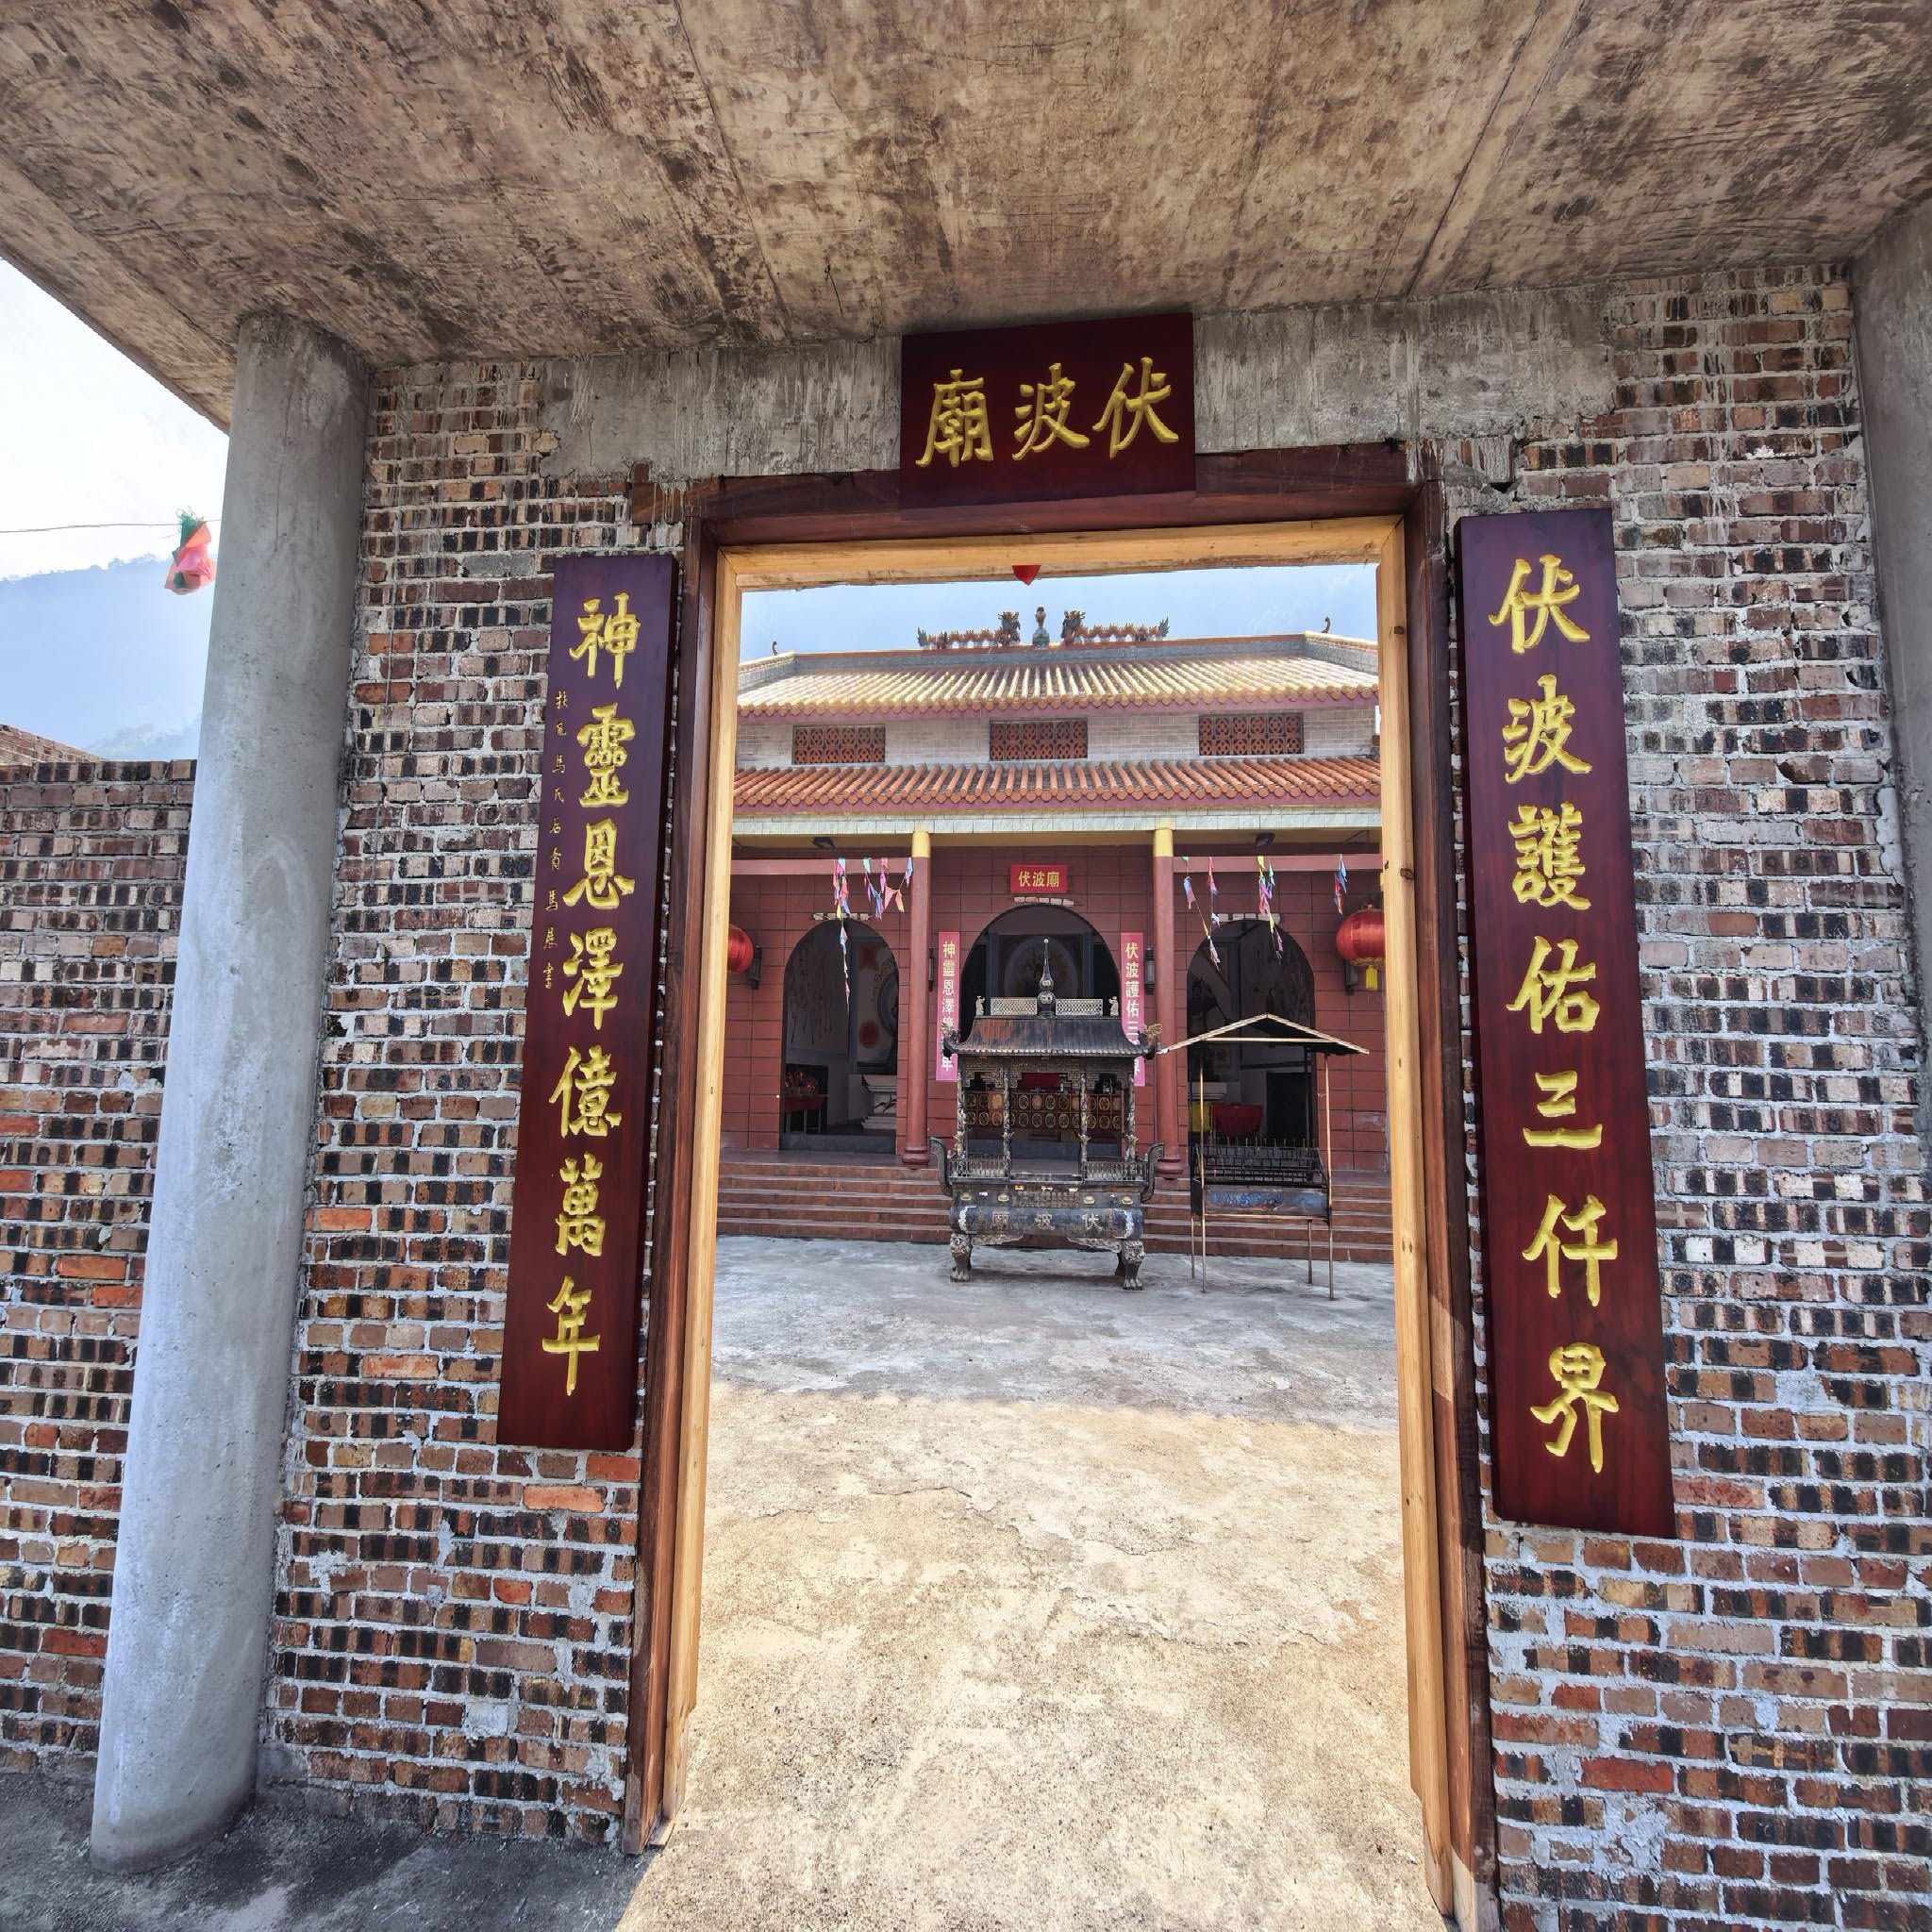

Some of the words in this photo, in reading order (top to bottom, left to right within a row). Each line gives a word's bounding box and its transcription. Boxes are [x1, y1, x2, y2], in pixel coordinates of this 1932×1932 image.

[915, 357, 1178, 467] 伏波廟
[1019, 871, 1059, 888] 伏波廟
[541, 592, 641, 1395] 神靈恩澤億萬年
[941, 941, 956, 1073] 神靈恩澤年
[1124, 942, 1141, 1076] 伏波護佑三
[1488, 554, 1619, 1473] 伏波護佑三仟界
